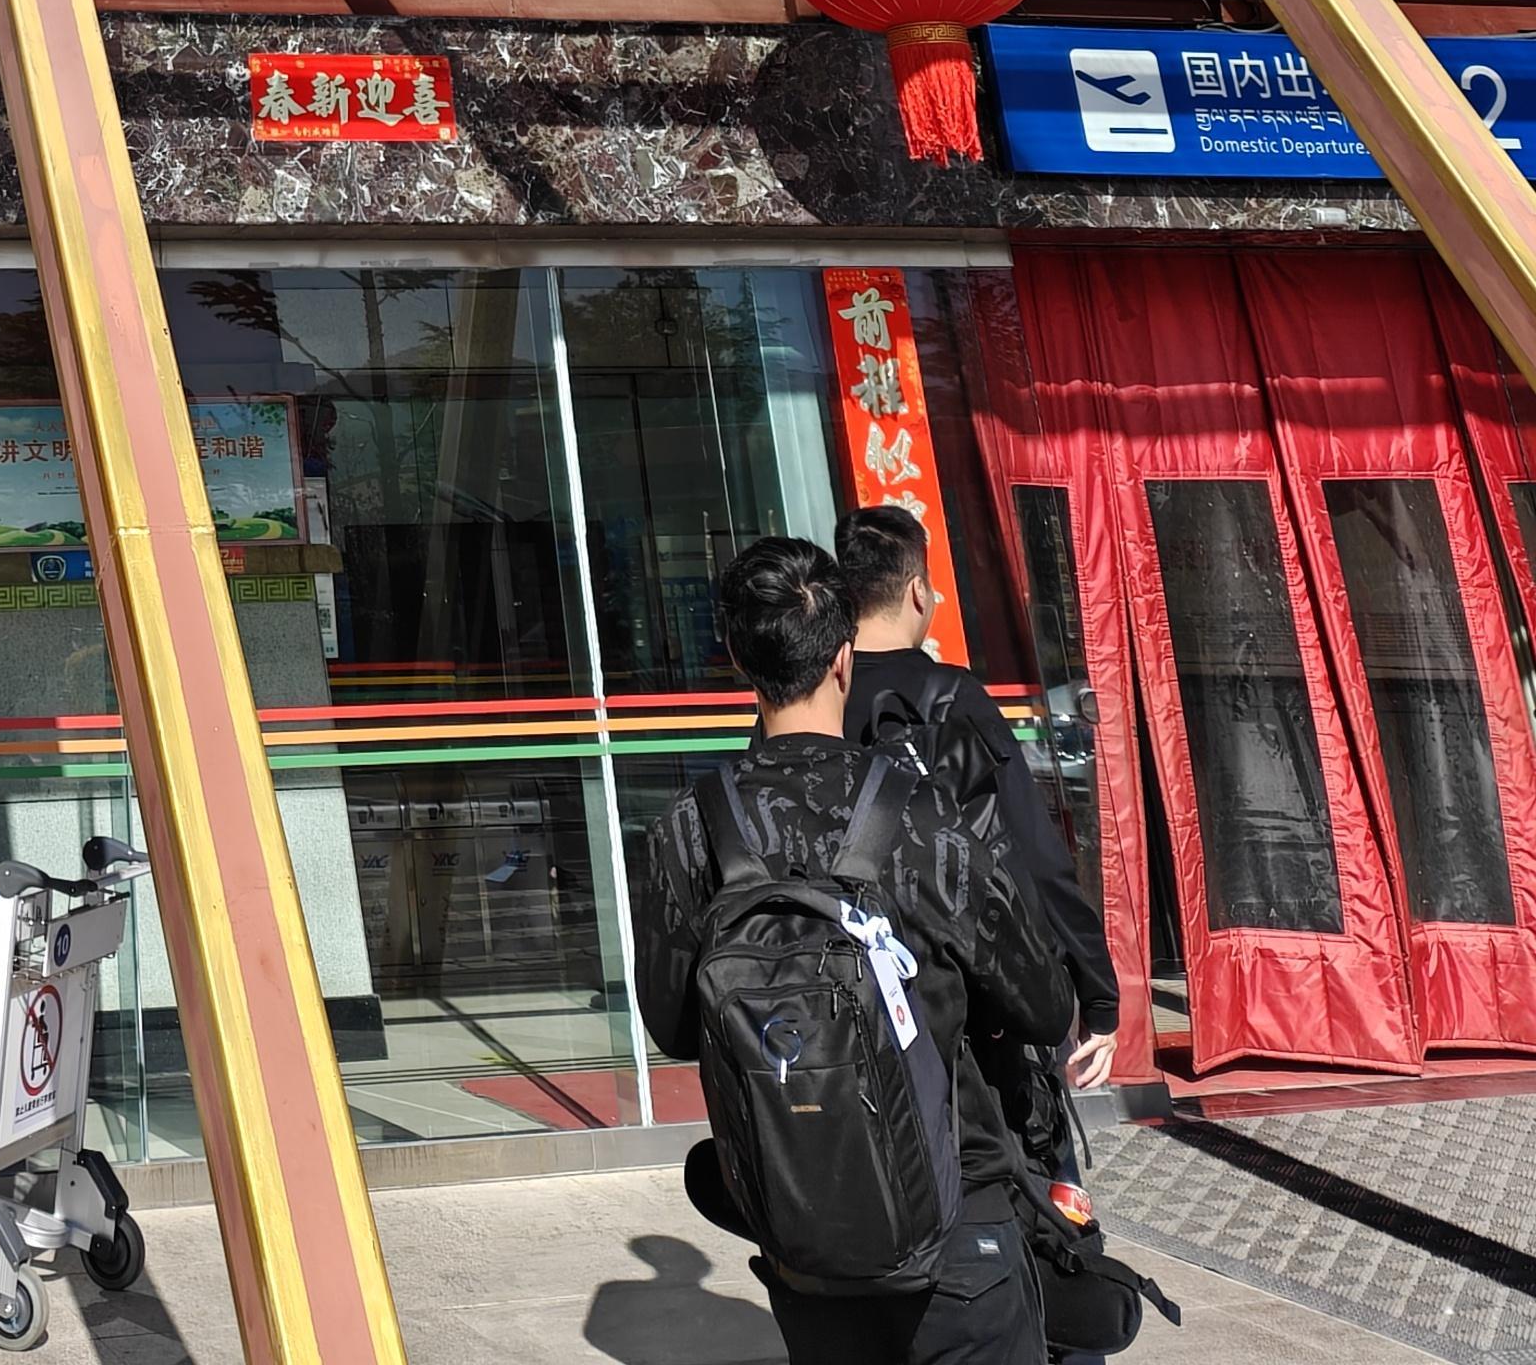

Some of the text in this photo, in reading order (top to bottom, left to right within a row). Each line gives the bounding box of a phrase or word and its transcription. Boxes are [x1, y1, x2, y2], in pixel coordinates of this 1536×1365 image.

[1180, 51, 1332, 100] 国内出
[1460, 64, 1523, 150] 2
[1199, 135, 1371, 158] Domestic Departure
[56, 933, 69, 958] 10
